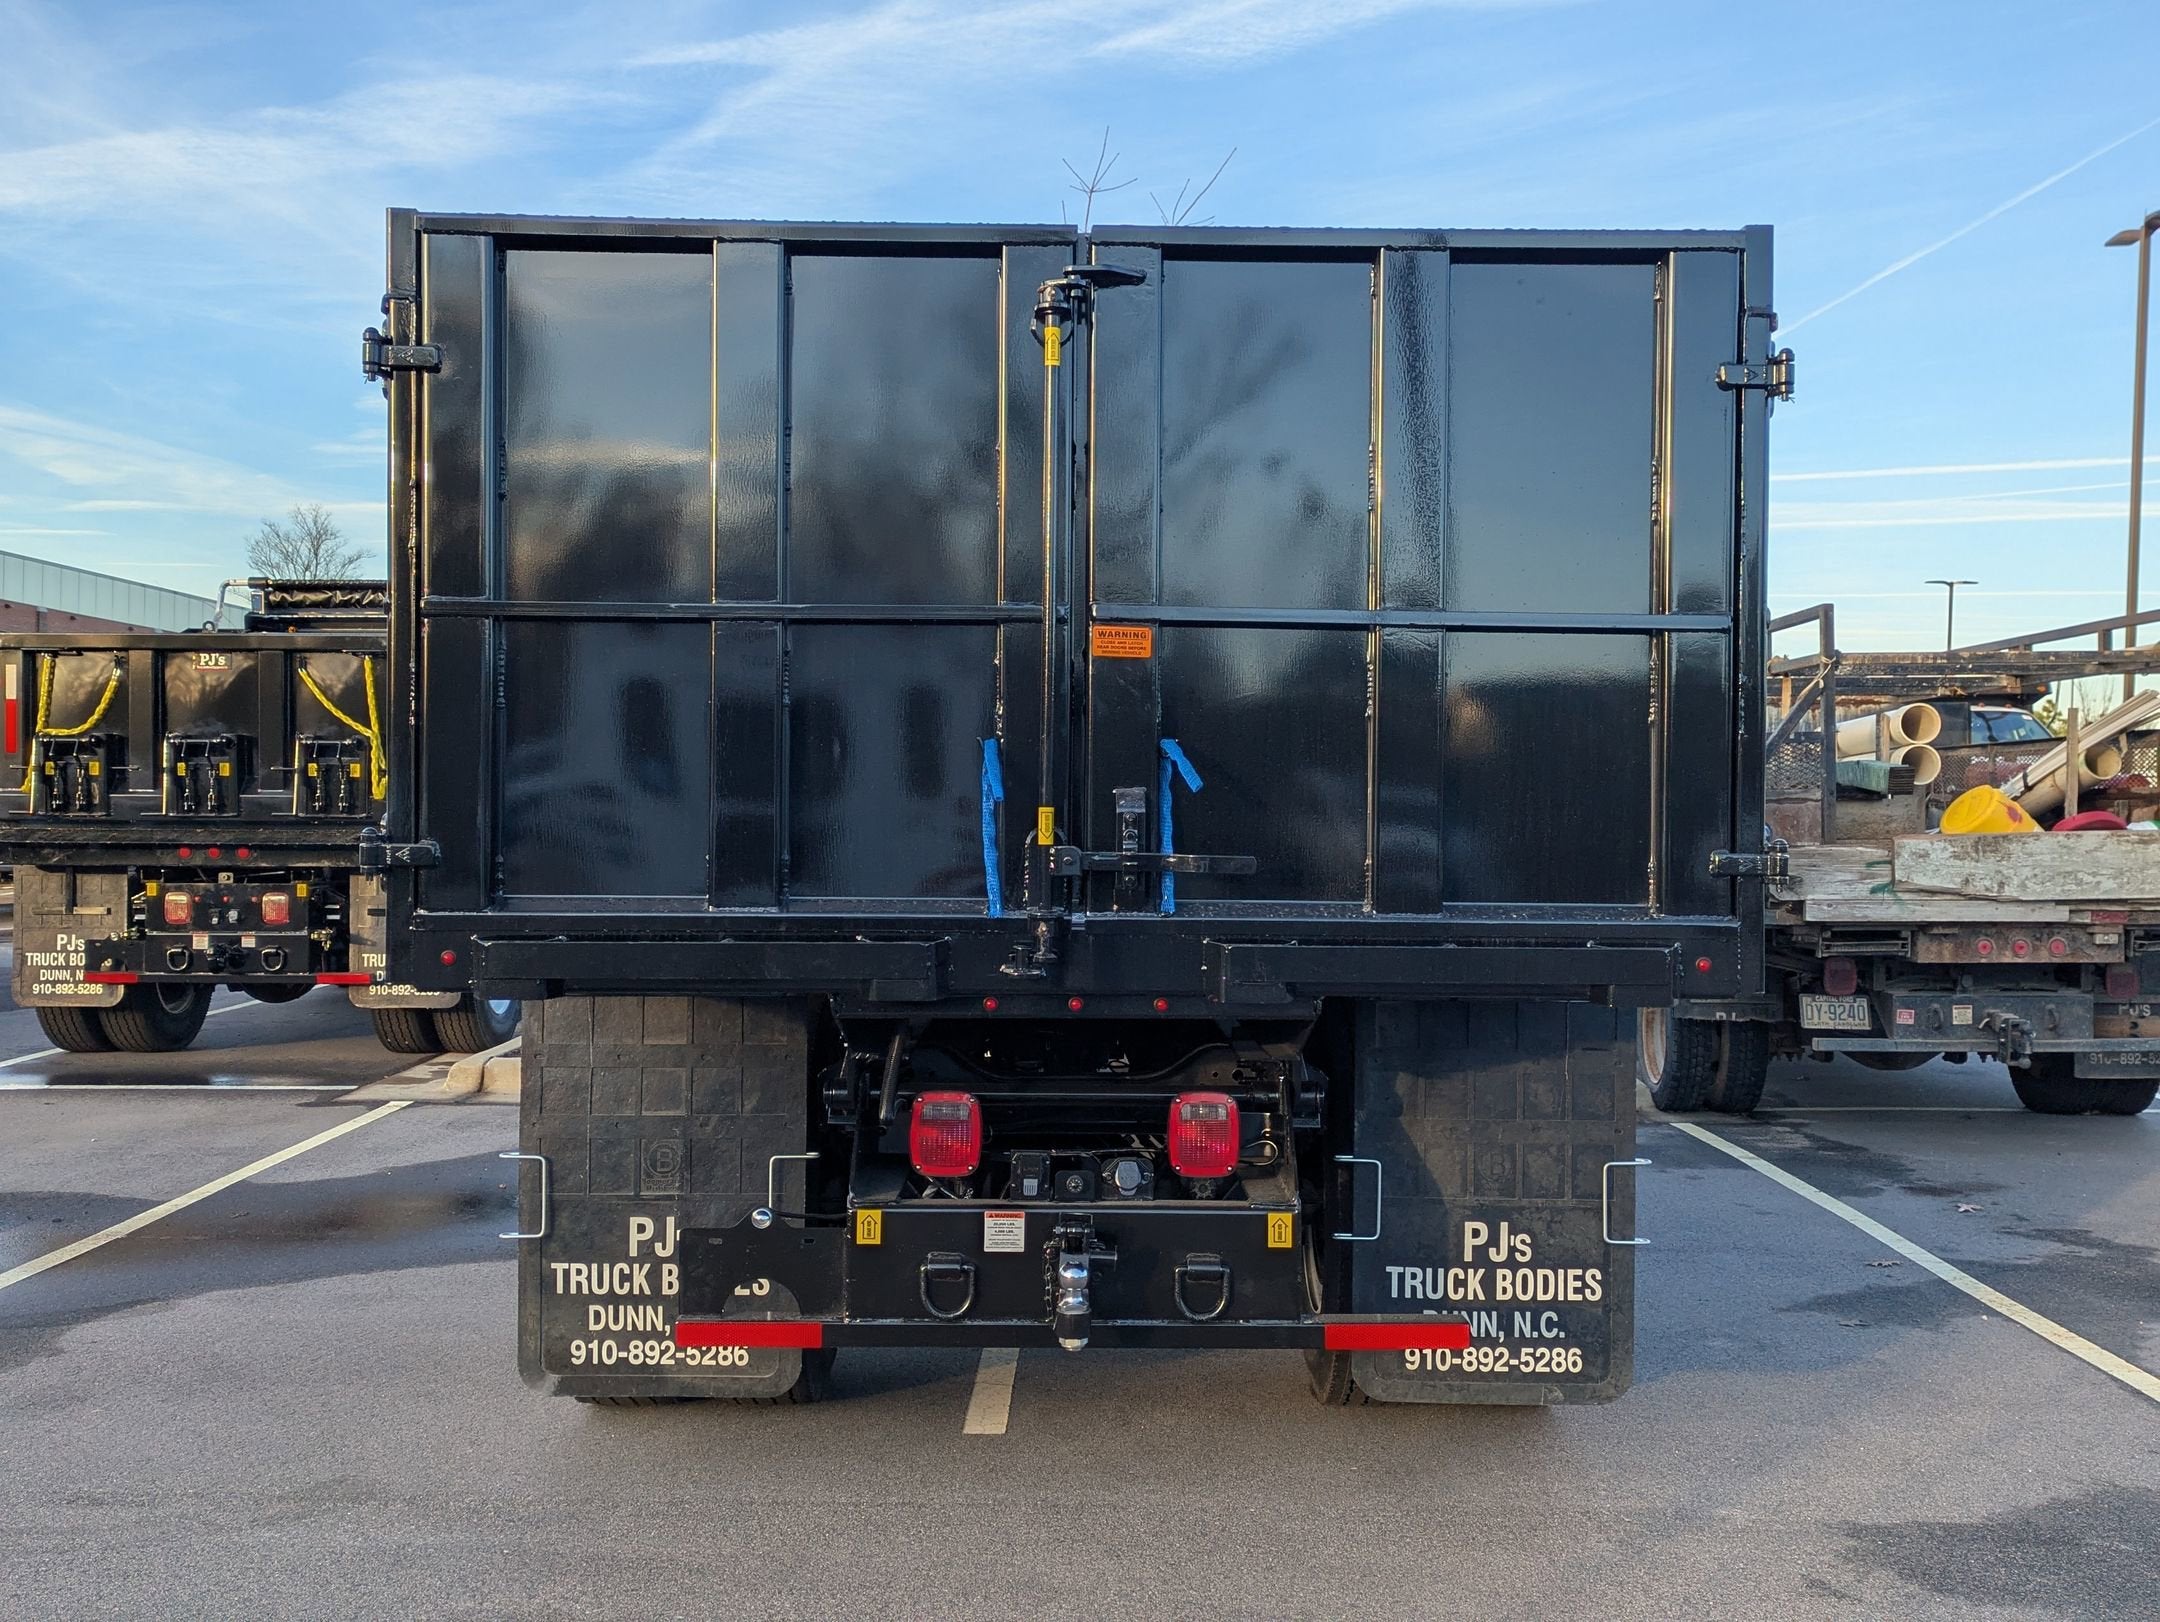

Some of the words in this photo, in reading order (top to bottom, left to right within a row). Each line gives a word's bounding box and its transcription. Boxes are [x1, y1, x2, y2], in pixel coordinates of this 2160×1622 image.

[1097, 630, 1147, 639] WARNING
[199, 653, 226, 666] PJ's
[56, 933, 86, 951] PJ's
[25, 952, 64, 966] TRUCK
[362, 953, 386, 967] TRU
[39, 969, 74, 982] DUNN,
[32, 983, 103, 995] 910-892-5286
[1806, 1003, 1866, 1022] DY-9240
[1463, 1221, 1532, 1263] PJ's
[551, 1262, 651, 1296] TRUCK
[1385, 1265, 1486, 1301] TRUCK
[1495, 1267, 1603, 1302] BODIES
[588, 1303, 671, 1337] DUNN,
[1513, 1311, 1566, 1339] N.C.
[570, 1339, 750, 1366] 910-892-5286
[1405, 1346, 1583, 1374] 910-892-5286
